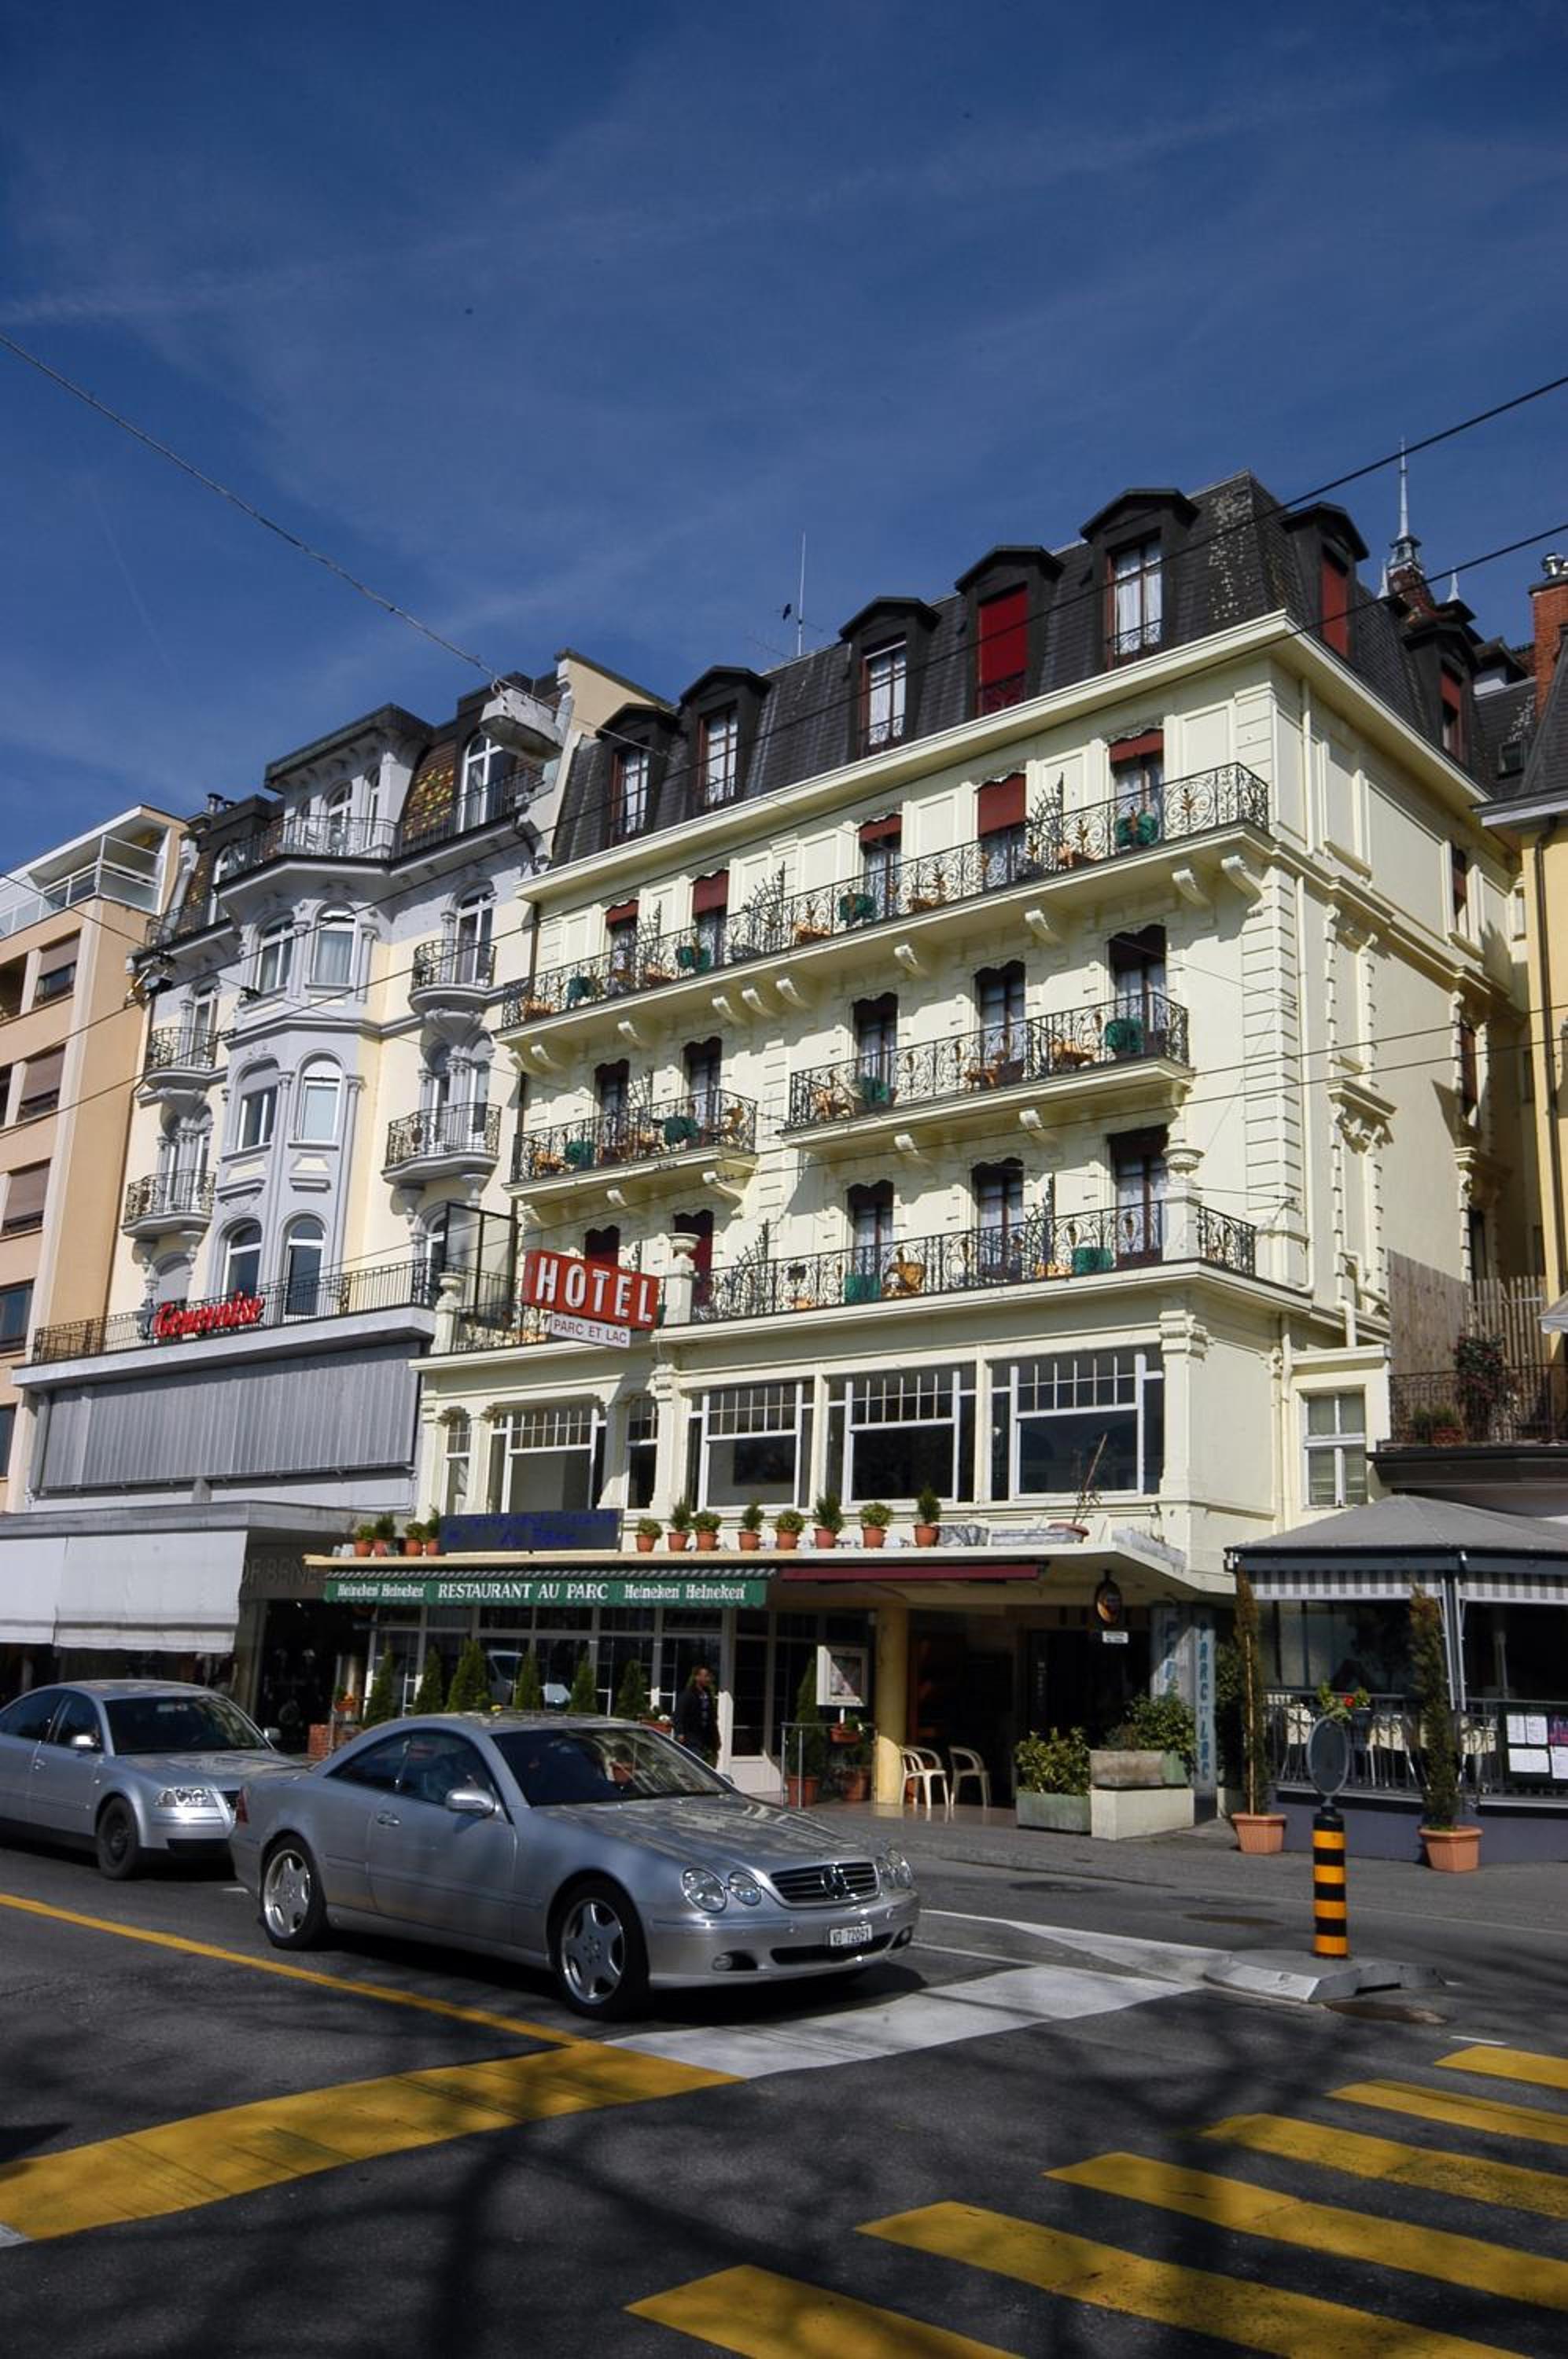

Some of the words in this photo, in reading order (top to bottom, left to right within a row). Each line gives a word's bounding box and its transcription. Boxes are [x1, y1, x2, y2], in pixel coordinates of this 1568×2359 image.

[536, 1257, 653, 1323] HOTEL
[554, 1319, 583, 1334] PARC
[589, 1326, 601, 1338] ET
[606, 1328, 627, 1343] LAC
[439, 1583, 533, 1599] RESTAURANT
[538, 1583, 560, 1599] AU
[566, 1583, 609, 1599] PARC
[624, 1584, 679, 1599] Heineken
[686, 1584, 745, 1599] Heineken
[1199, 1621, 1209, 1701] PARC
